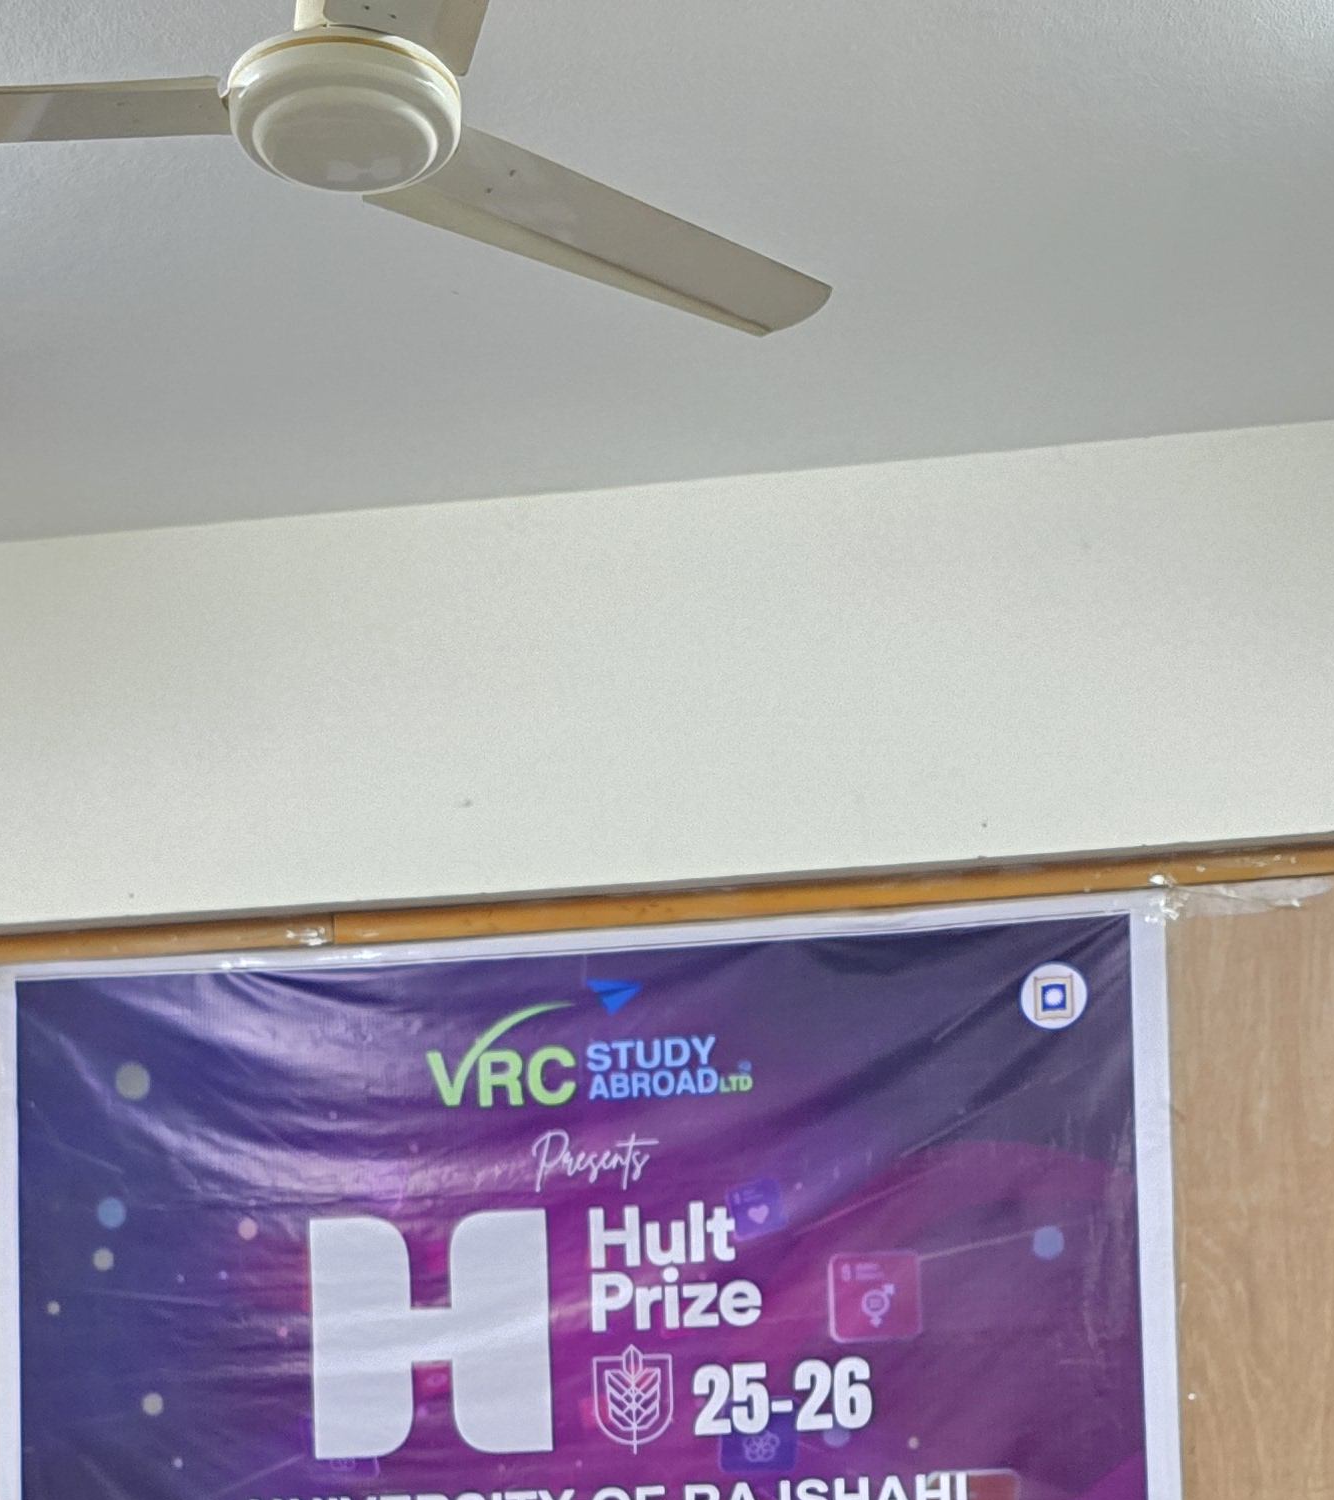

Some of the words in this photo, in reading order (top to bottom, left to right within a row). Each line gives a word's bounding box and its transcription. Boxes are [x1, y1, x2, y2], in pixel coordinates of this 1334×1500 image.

[426, 1001, 577, 1107] VRC
[586, 1035, 715, 1072] STUDY
[589, 1067, 718, 1100] ABROAD
[719, 1074, 753, 1093] LTD
[531, 1129, 659, 1193] Presents
[588, 1200, 736, 1269] Hult
[590, 1266, 762, 1333] Prize
[693, 1356, 873, 1436] 25-26
